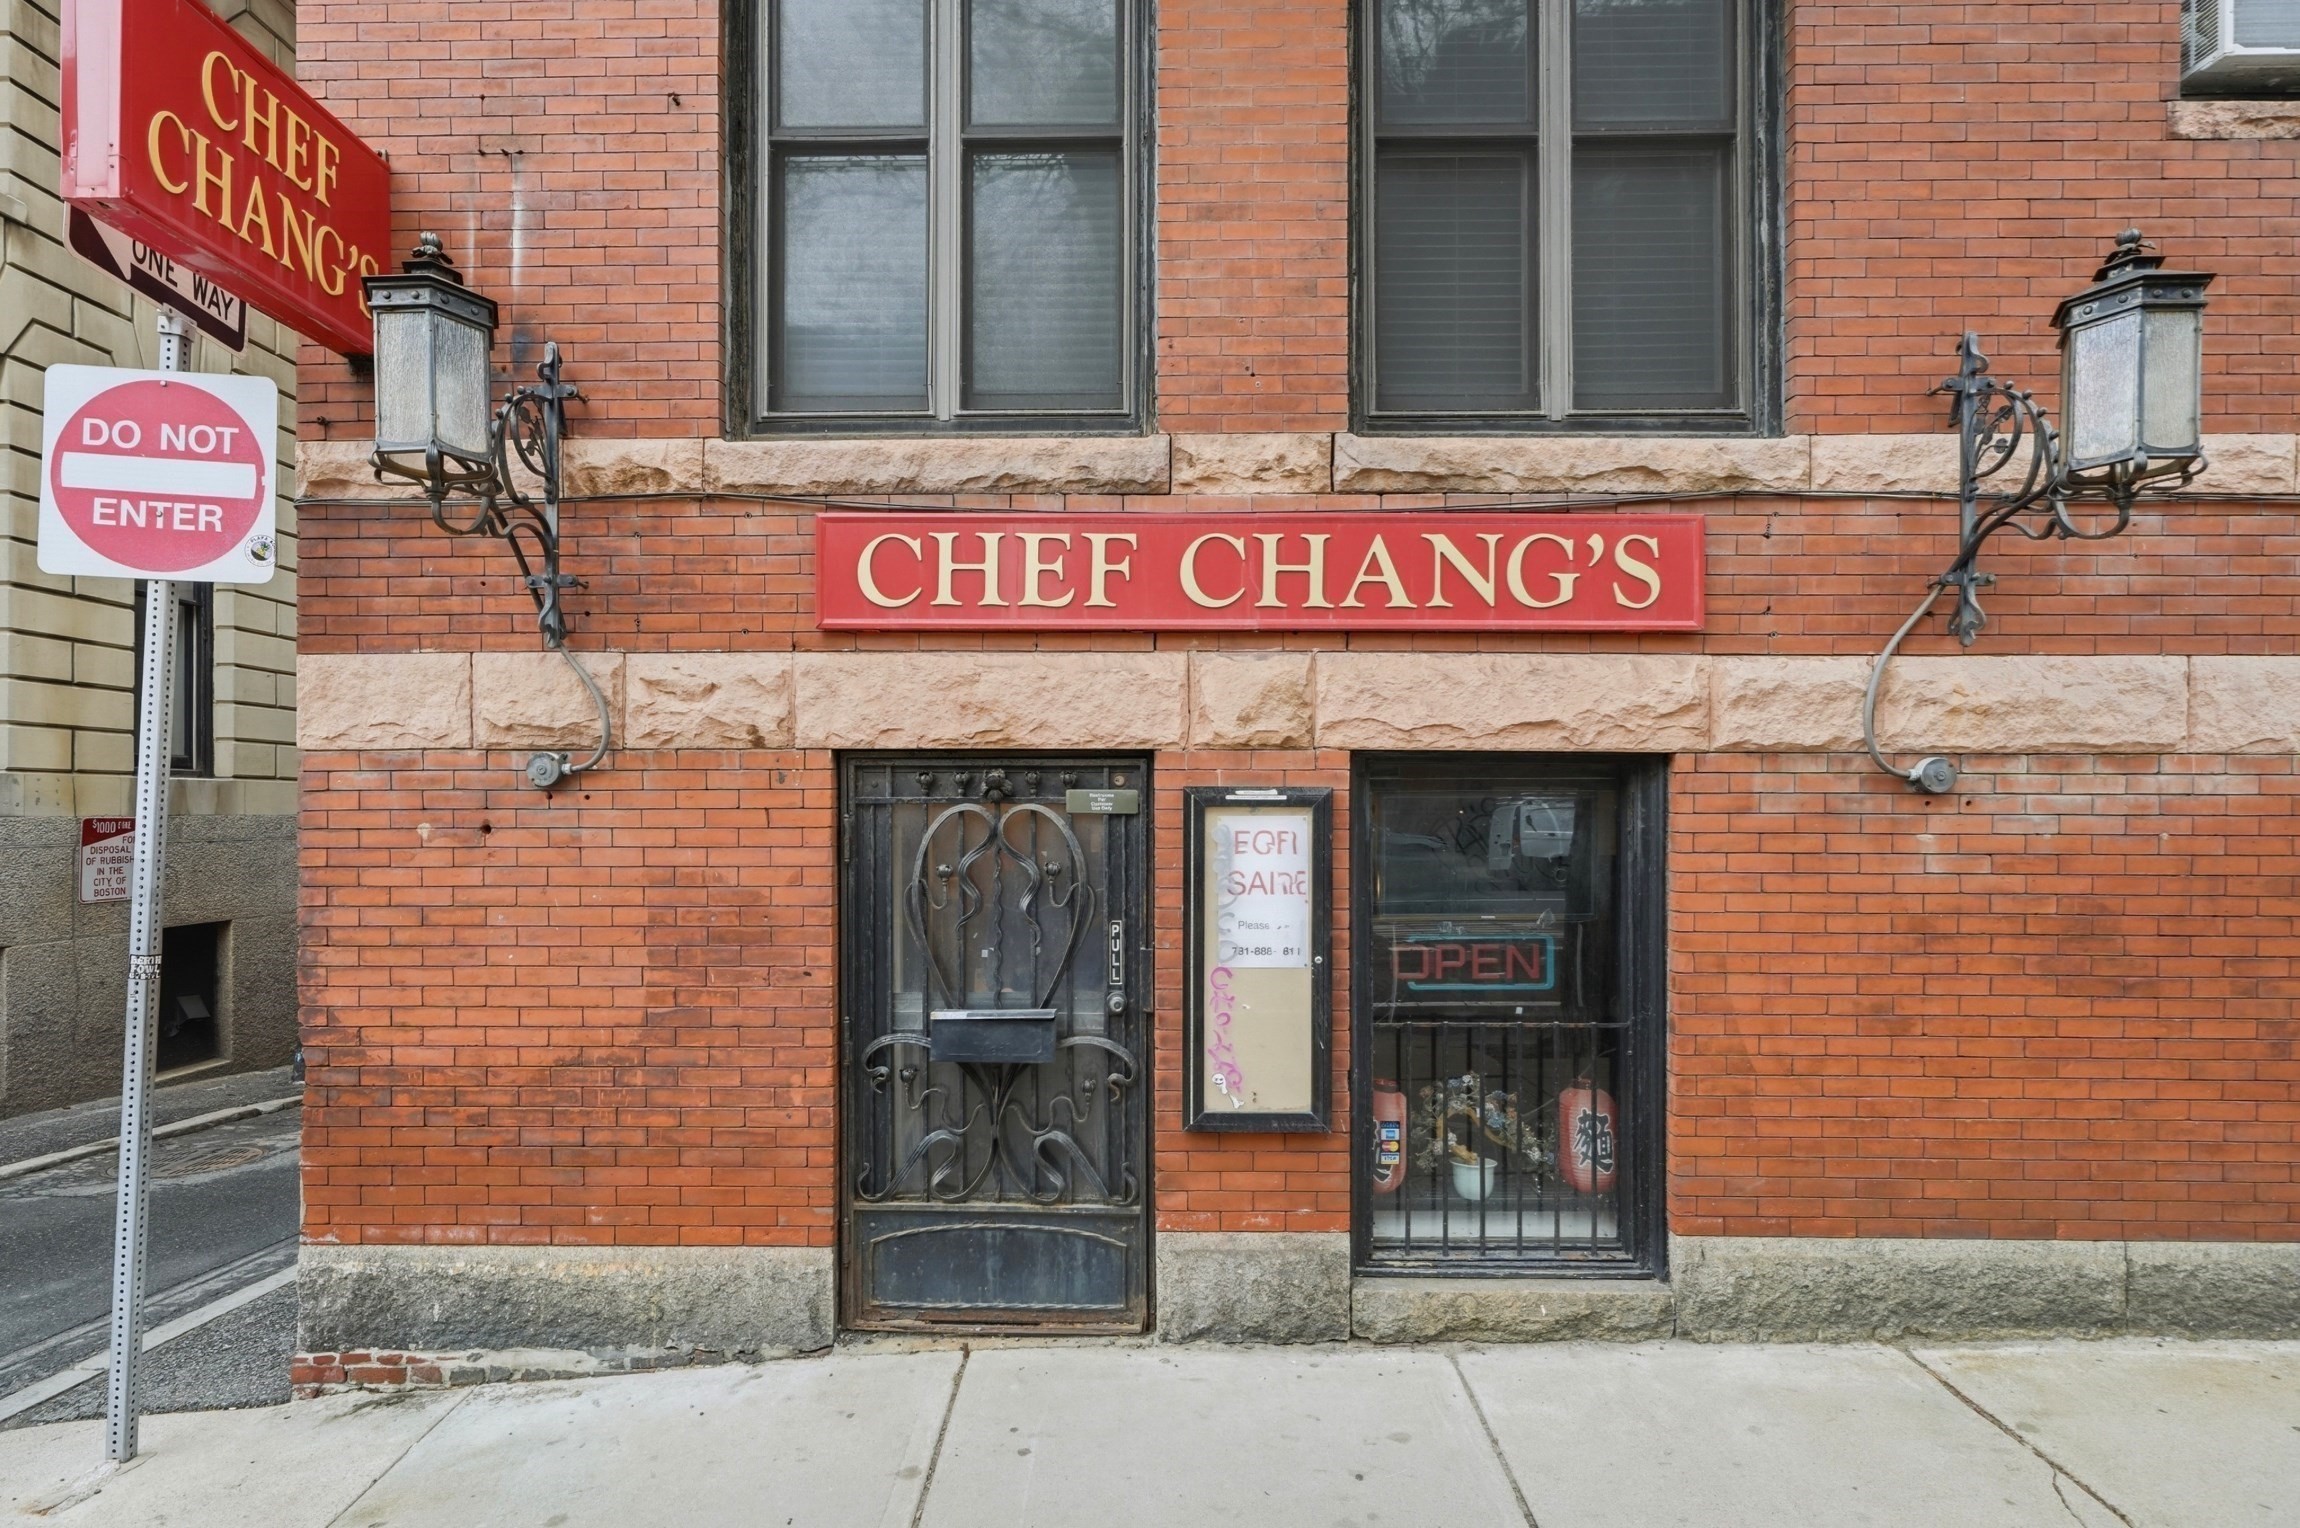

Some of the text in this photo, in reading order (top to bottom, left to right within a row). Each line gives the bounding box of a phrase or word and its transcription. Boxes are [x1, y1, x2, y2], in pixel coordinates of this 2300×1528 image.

[201, 51, 340, 208] CHEF
[132, 239, 234, 321] ONE WAY
[81, 417, 240, 455] DO NOT
[92, 497, 223, 533] ENTER
[856, 531, 1661, 609] CHEF CHANG'S
[92, 819, 116, 833] $1000
[85, 857, 97, 866] OF
[90, 845, 132, 855] DISPOSAL
[93, 876, 127, 887] CITY OF
[96, 866, 124, 876] IN THE
[93, 887, 126, 898] BOSTON
[1237, 920, 1270, 930] Please
[1111, 924, 1120, 981] PULL
[1392, 943, 1541, 980] OPEN
